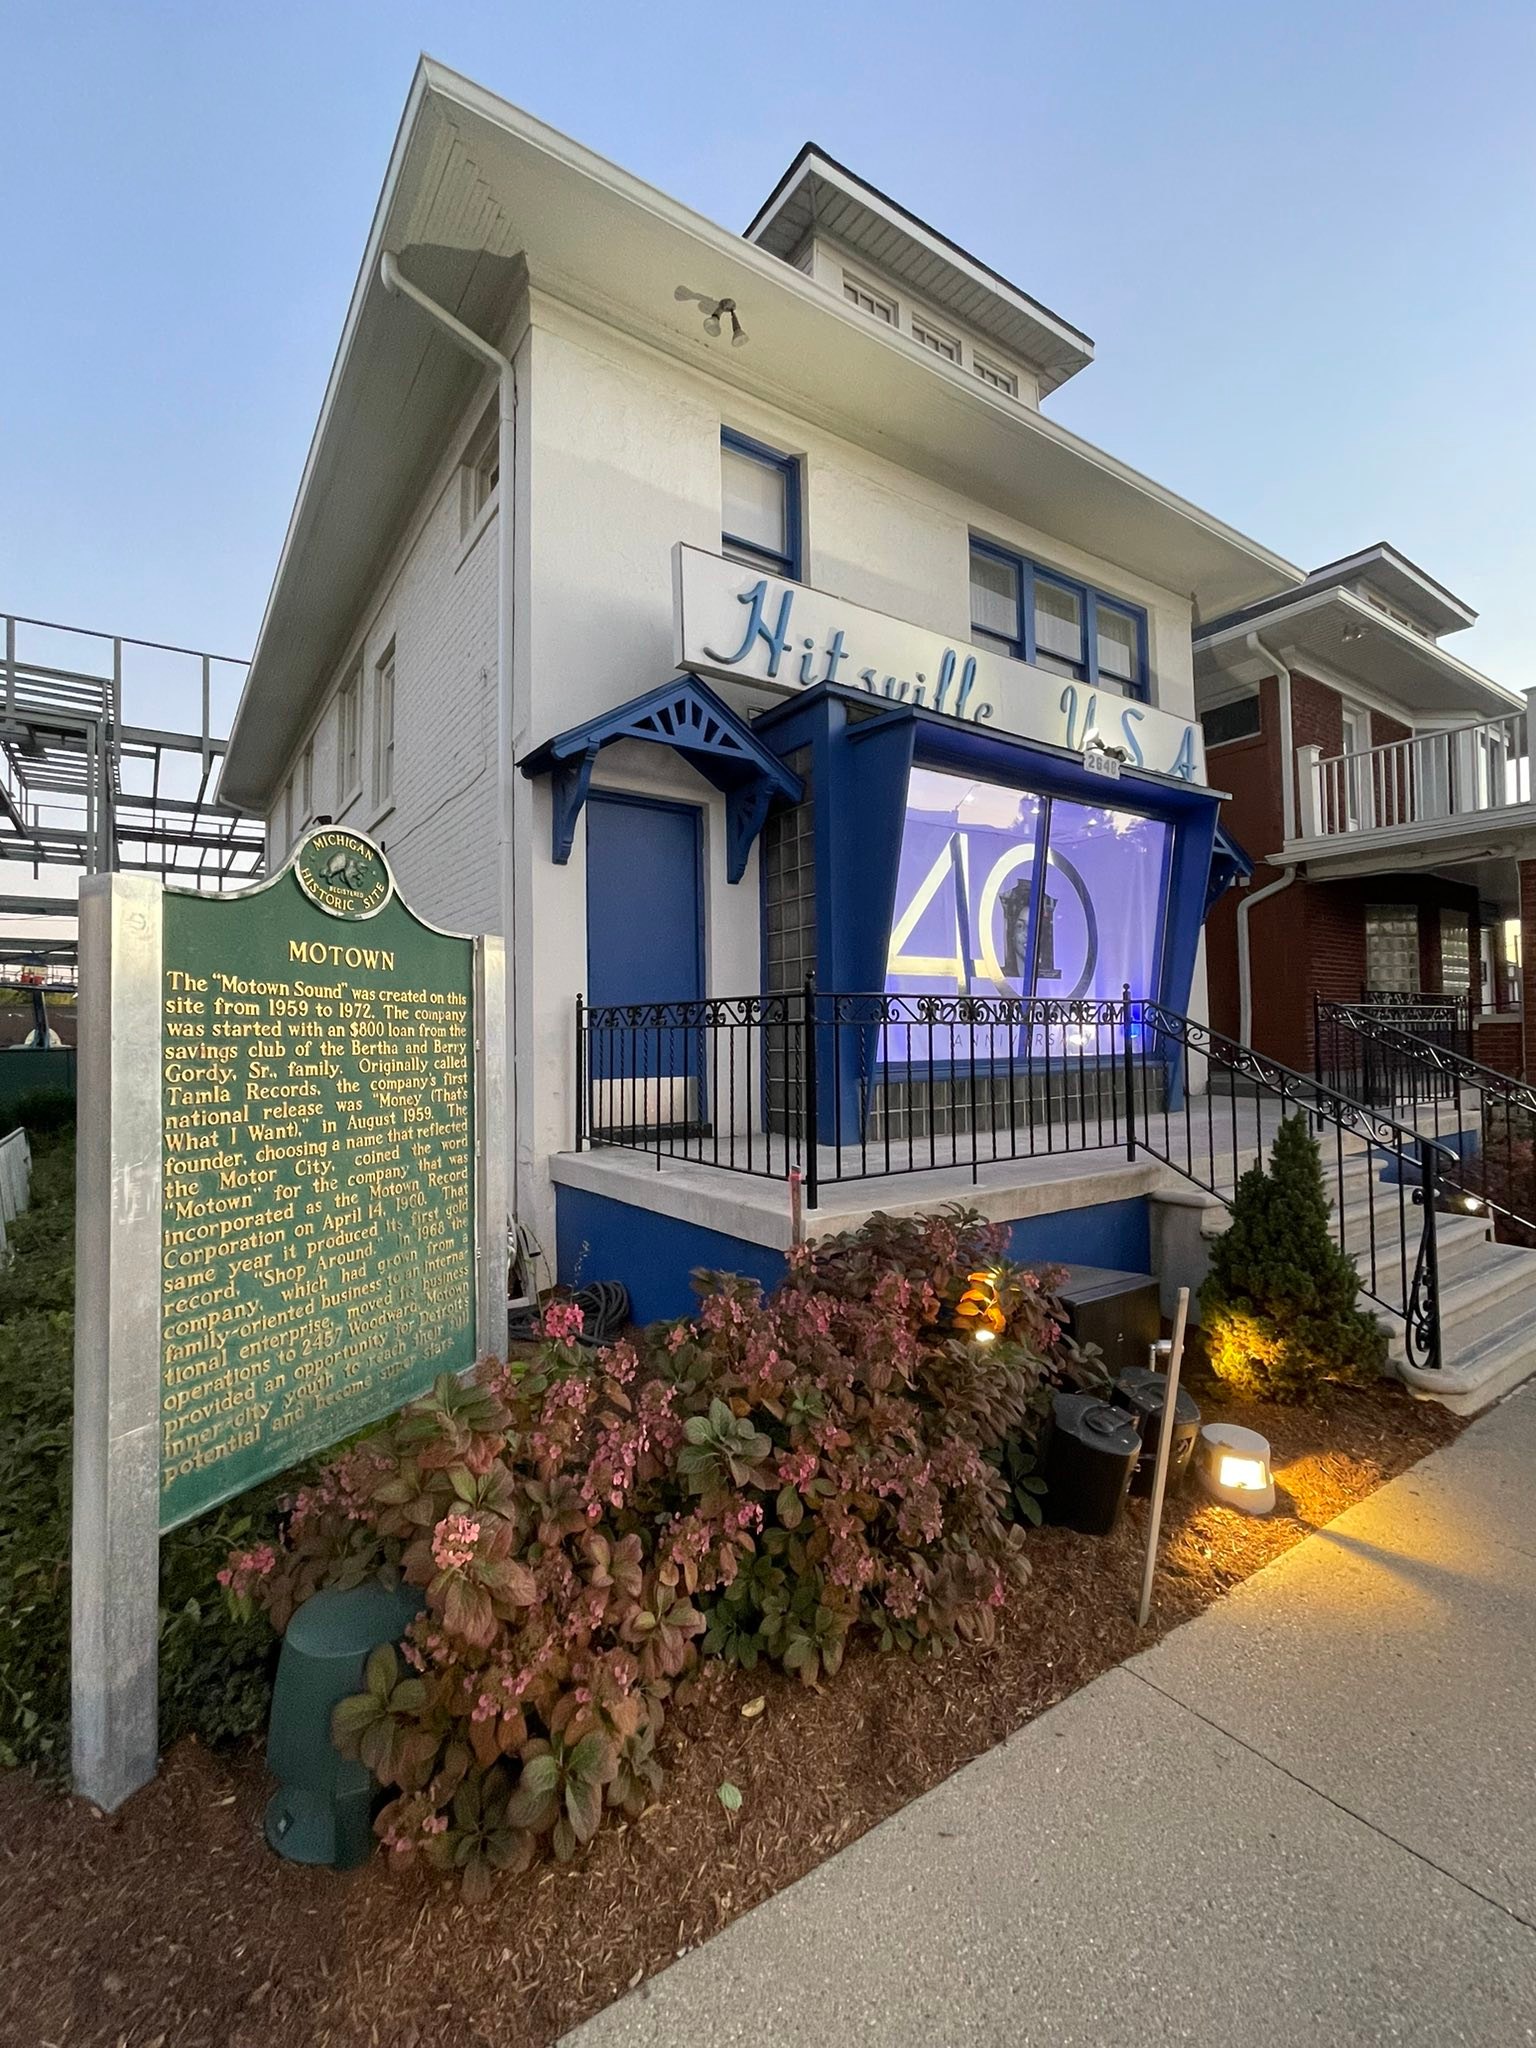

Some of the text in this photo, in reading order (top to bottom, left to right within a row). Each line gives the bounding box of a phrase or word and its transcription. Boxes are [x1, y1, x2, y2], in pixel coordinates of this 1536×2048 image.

[313, 835, 374, 862] MICHIGAN
[301, 868, 385, 911] HISTORIC SITE
[329, 886, 364, 898] REGISTERED
[289, 940, 394, 971] MOTOWN
[166, 971, 466, 1005] The "Motown Sound" was created on this
[166, 997, 466, 1023] site from 1959 to 1972. The company
[165, 1039, 466, 1063] savings club of the Bertha and Berry
[166, 1021, 466, 1038] was started with an $800 loan from the
[165, 1056, 467, 1084] Gordy, Sr., family. Originally called
[167, 1073, 467, 1105] Tamla Records, the company's first
[165, 1087, 468, 1130] national release was "Money (That's
[165, 1103, 468, 1152] What I Want)," in August 1959. The
[165, 1120, 468, 1176] founder, choosing a name that reflected
[165, 1136, 468, 1200] the Motor City, coined the word
[164, 1153, 468, 1221] "Motown" for the company that was
[164, 1168, 468, 1249] incorporated as the Motown Record
[163, 1184, 468, 1269] Corporation on April 14, 1960. That
[163, 1201, 468, 1294] same year it produced its first gold
[163, 1217, 468, 1318] record, "Shop Around." In 1968 the
[163, 1233, 468, 1342] company, which had grown from a
[163, 1252, 468, 1364] family-oriented business to an interna-
[163, 1350, 227, 1387] tional
[239, 1317, 333, 1359] enterprise,
[346, 1293, 392, 1319] moved
[421, 1265, 468, 1291] business
[163, 1358, 271, 1412] operations
[276, 1348, 296, 1363] to
[301, 1327, 342, 1357] 2457
[427, 1281, 468, 1303] Motown
[163, 1383, 256, 1439] provided
[264, 1374, 285, 1392] an
[293, 1332, 386, 1380] opportunity
[396, 1320, 415, 1336] for
[164, 1401, 273, 1458] inner-city
[284, 1374, 333, 1407] youth
[343, 1364, 360, 1377] to
[366, 1339, 406, 1367] reach
[163, 1424, 260, 1486] potential
[272, 1407, 304, 1432] and
[315, 1374, 372, 1411] become
